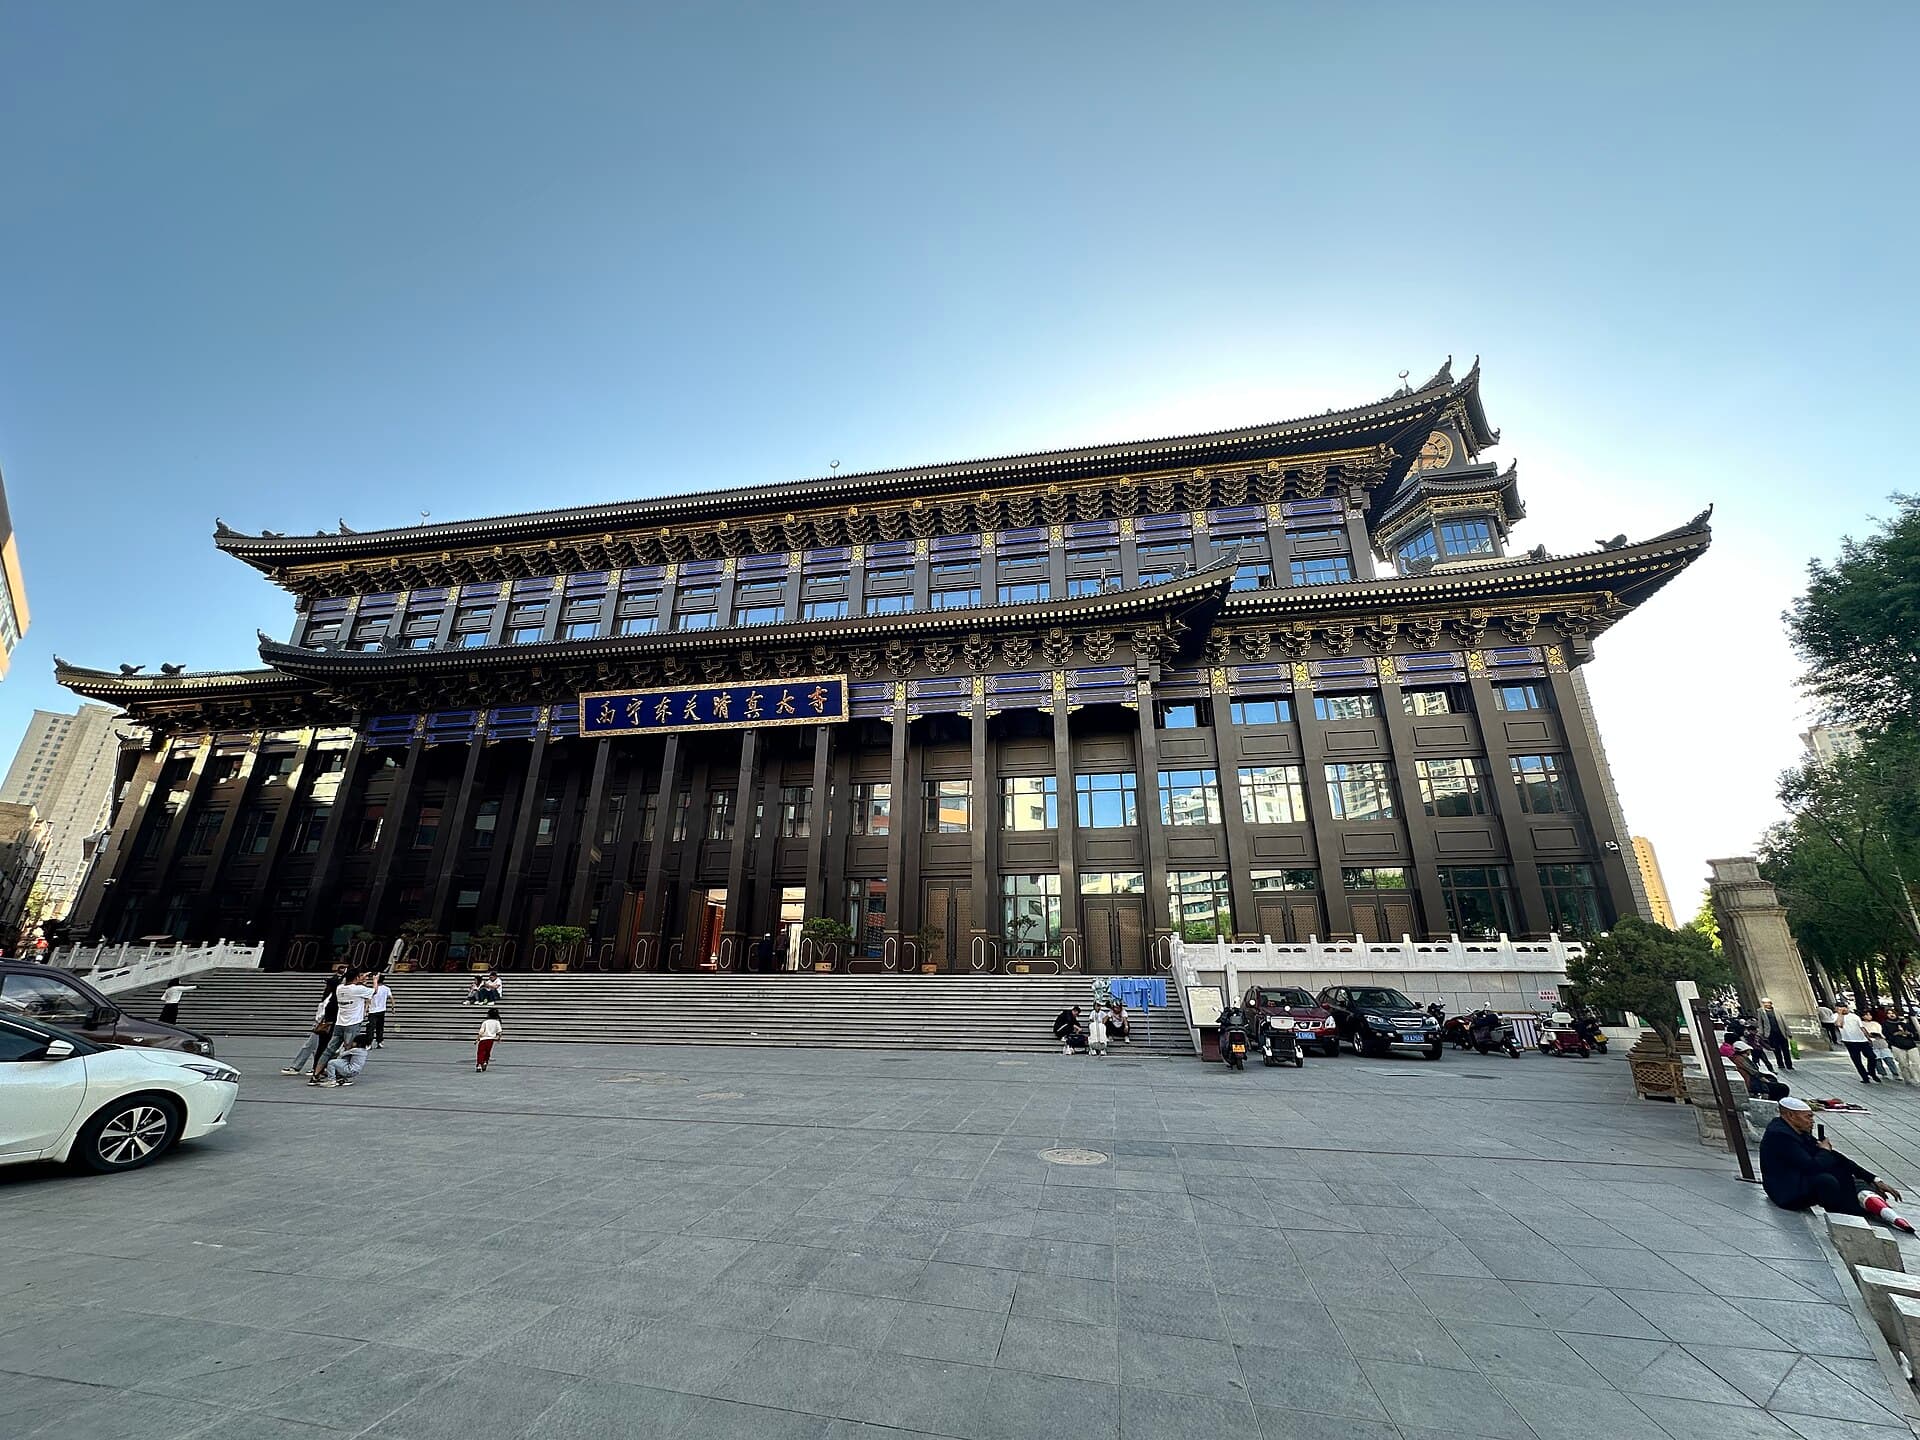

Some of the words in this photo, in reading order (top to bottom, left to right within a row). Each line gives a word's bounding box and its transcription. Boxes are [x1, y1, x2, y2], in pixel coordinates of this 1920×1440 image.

[596, 685, 828, 726] 西宁东关清真大寺
